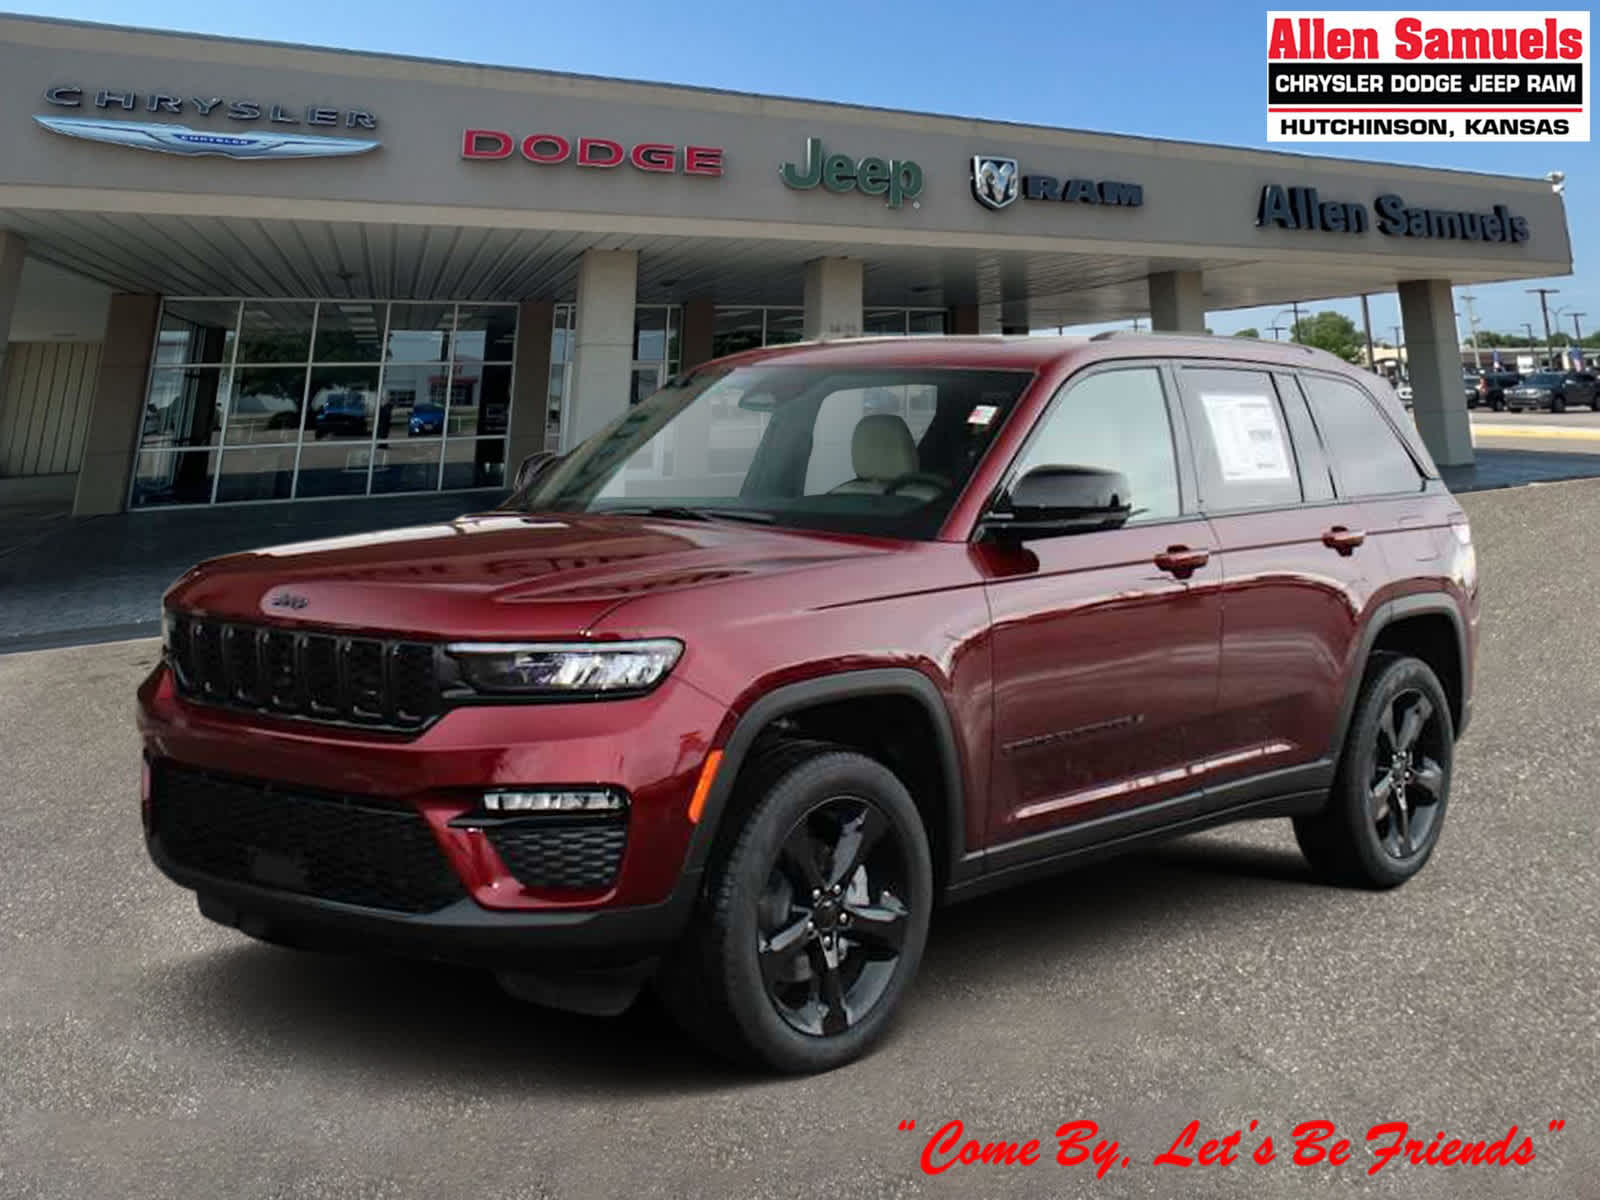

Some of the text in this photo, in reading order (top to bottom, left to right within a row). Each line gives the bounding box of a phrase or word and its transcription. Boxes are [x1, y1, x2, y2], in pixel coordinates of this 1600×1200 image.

[45, 86, 378, 128] CHRYSLER
[461, 128, 724, 177] DODGE
[779, 137, 923, 209] Jeep
[1023, 174, 1144, 208] RAM
[1256, 184, 1530, 243] Allen Samuels
